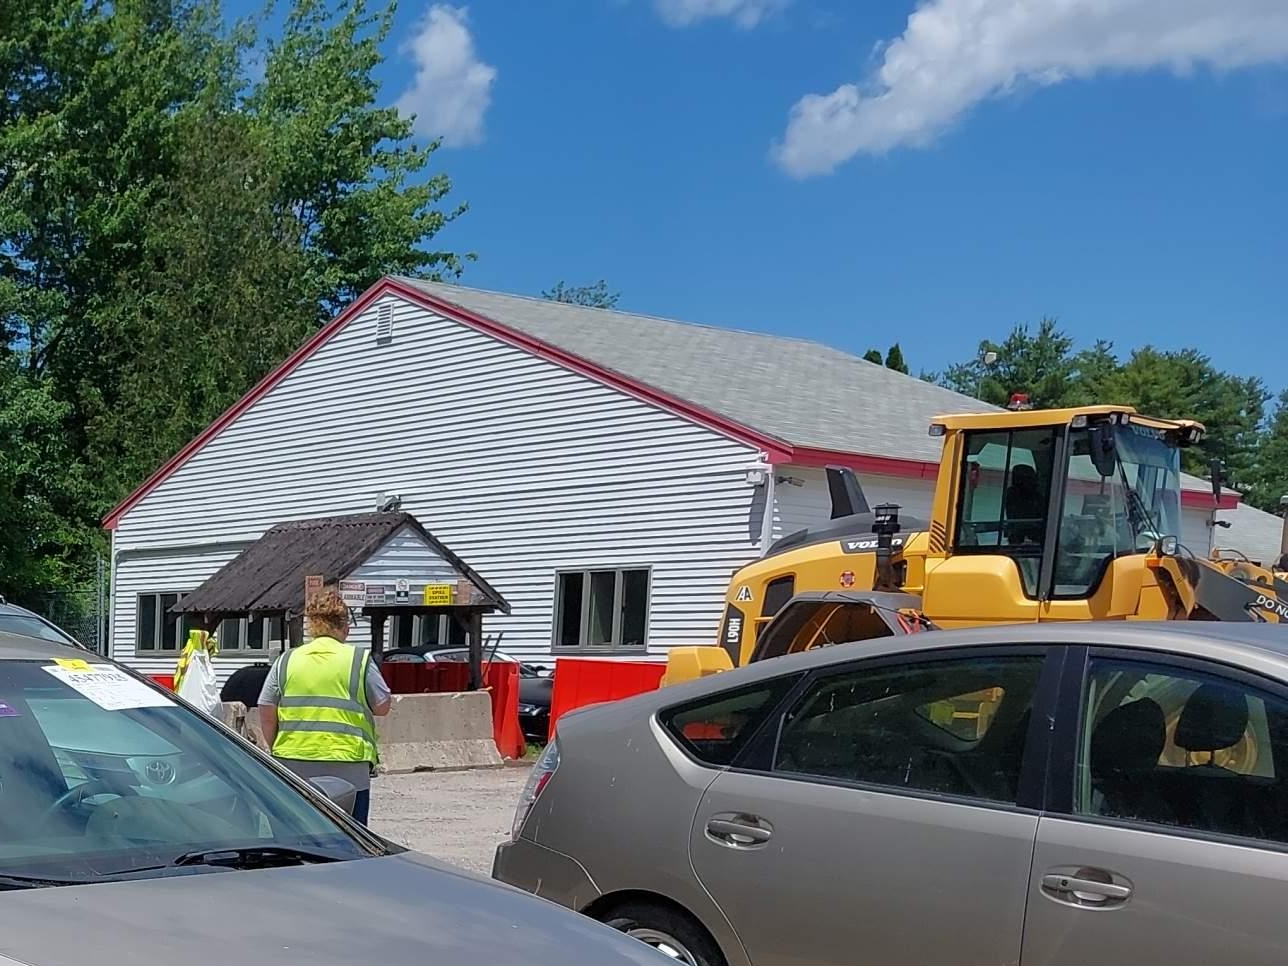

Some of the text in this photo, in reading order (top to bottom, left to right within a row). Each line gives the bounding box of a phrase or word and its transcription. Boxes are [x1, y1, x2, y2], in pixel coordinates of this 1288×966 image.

[848, 539, 902, 550] VOLO
[1256, 595, 1275, 609] DO
[727, 618, 741, 643] L90H
